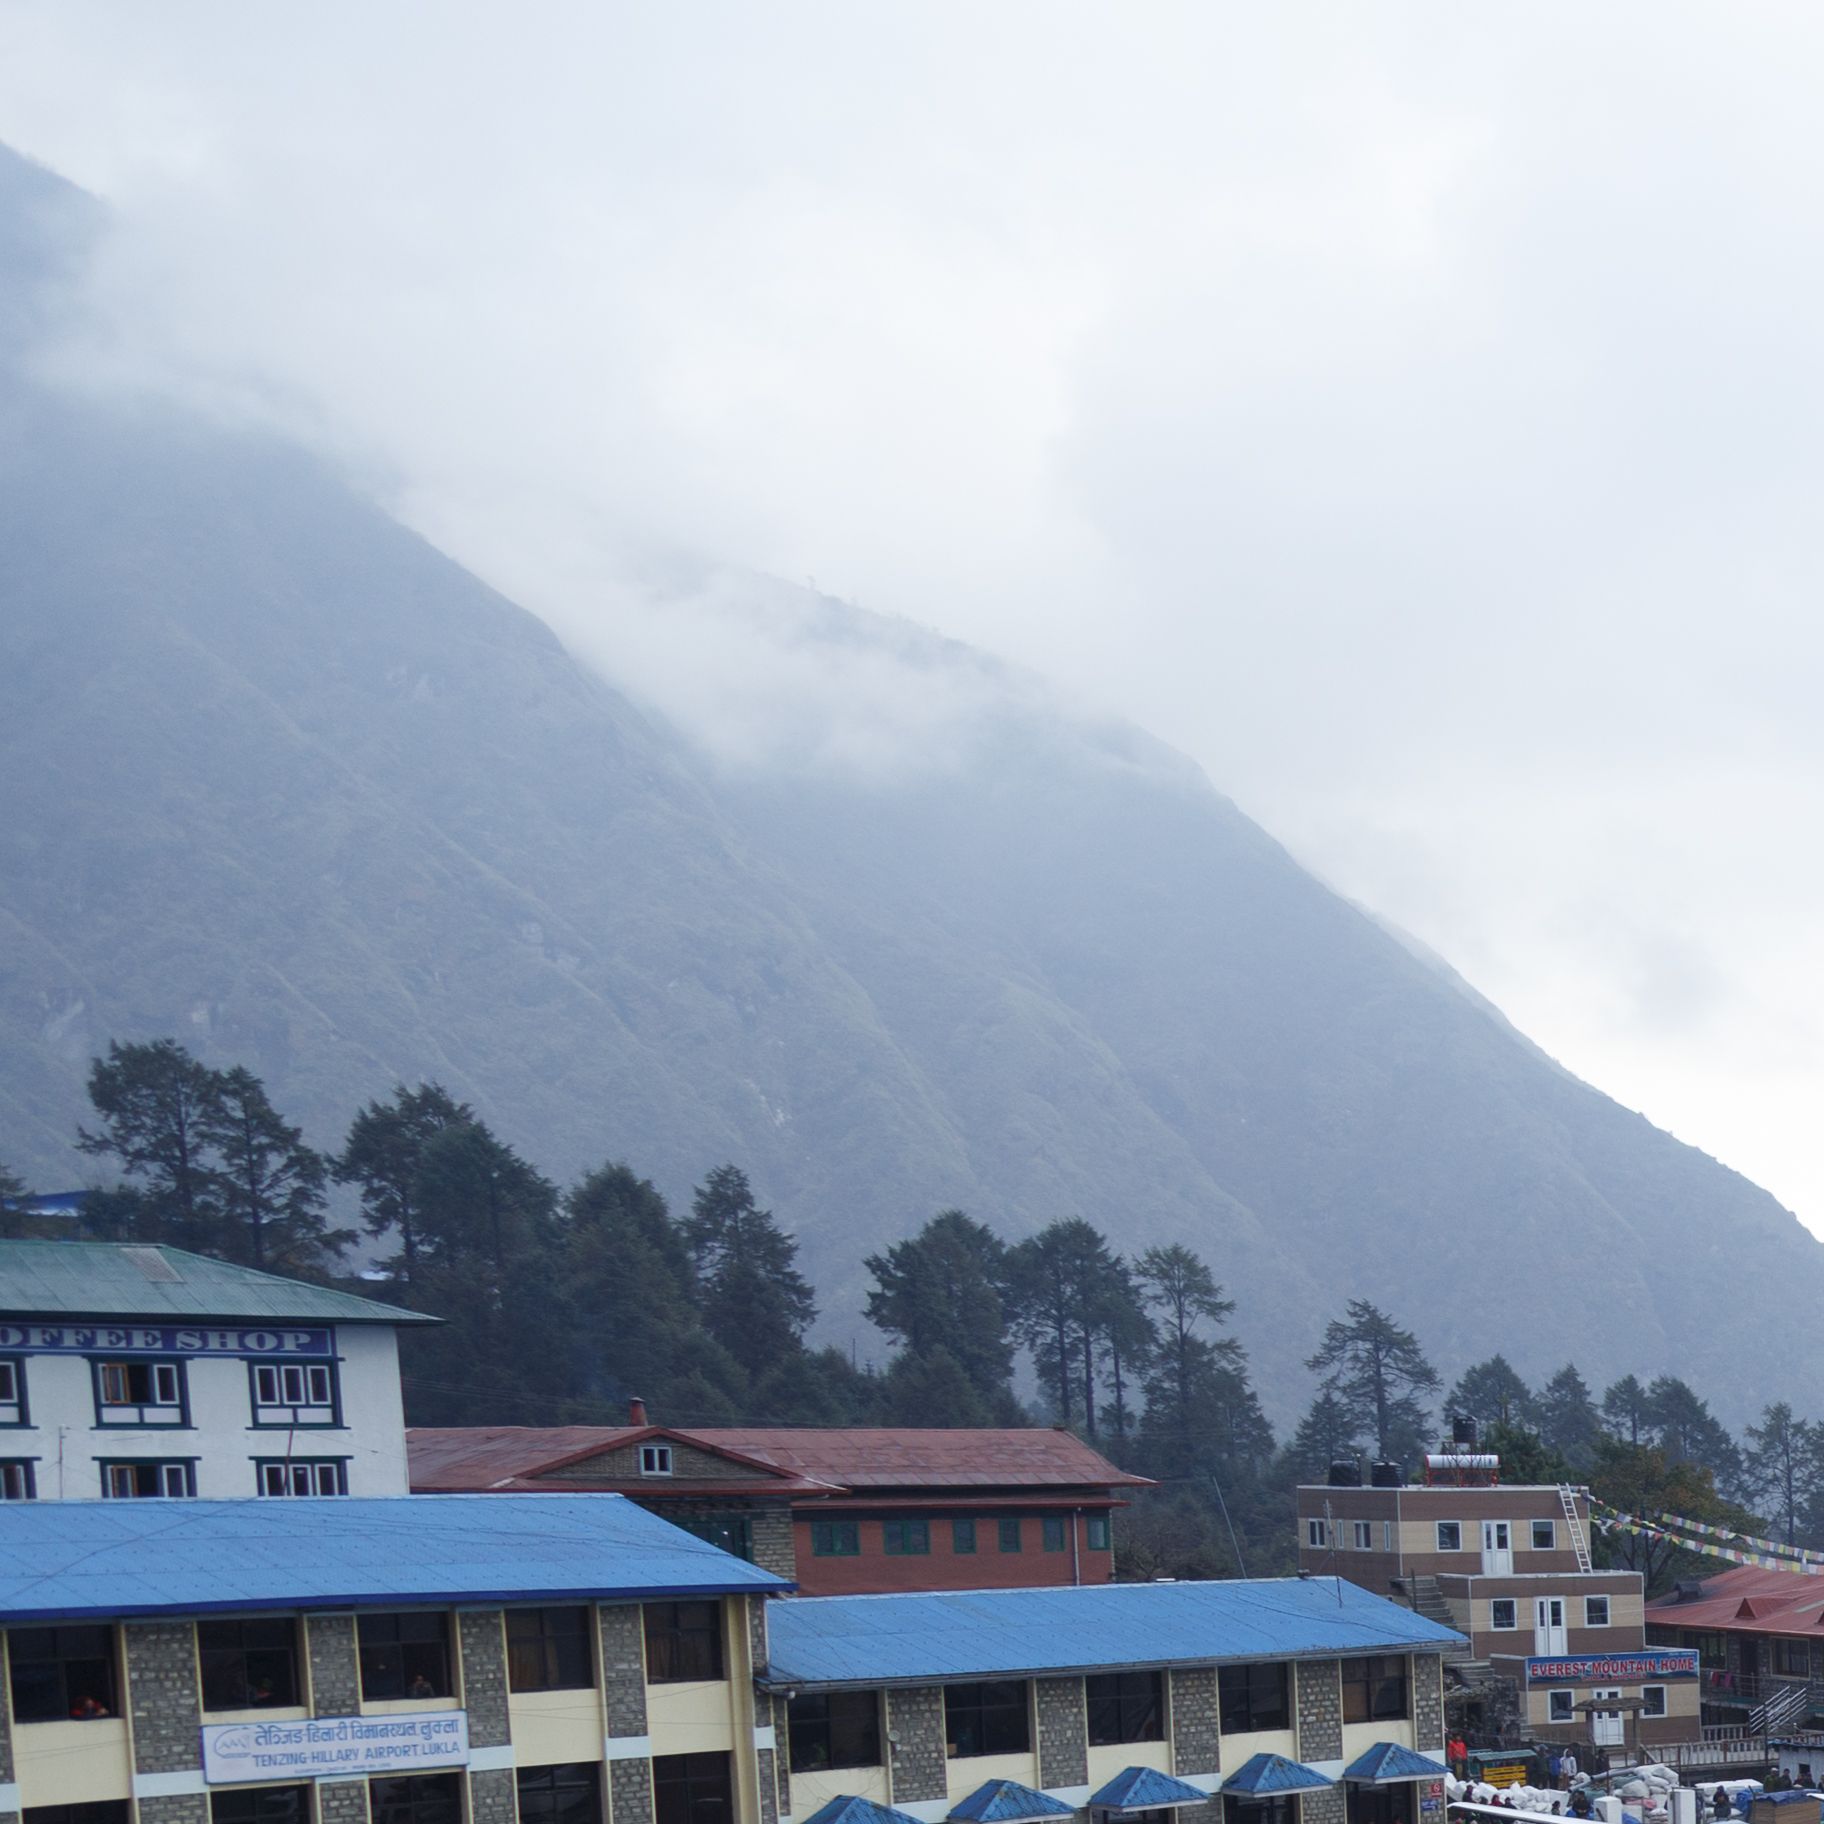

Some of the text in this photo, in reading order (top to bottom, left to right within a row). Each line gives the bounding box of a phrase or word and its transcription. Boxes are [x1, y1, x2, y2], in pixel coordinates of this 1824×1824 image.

[175, 1329, 312, 1351] SHOP
[1531, 1662, 1588, 1677] EVEREST
[1592, 1659, 1656, 1674] MOUNTAIN
[1660, 1657, 1695, 1671] HOME
[422, 1741, 460, 1756] LUKLA
